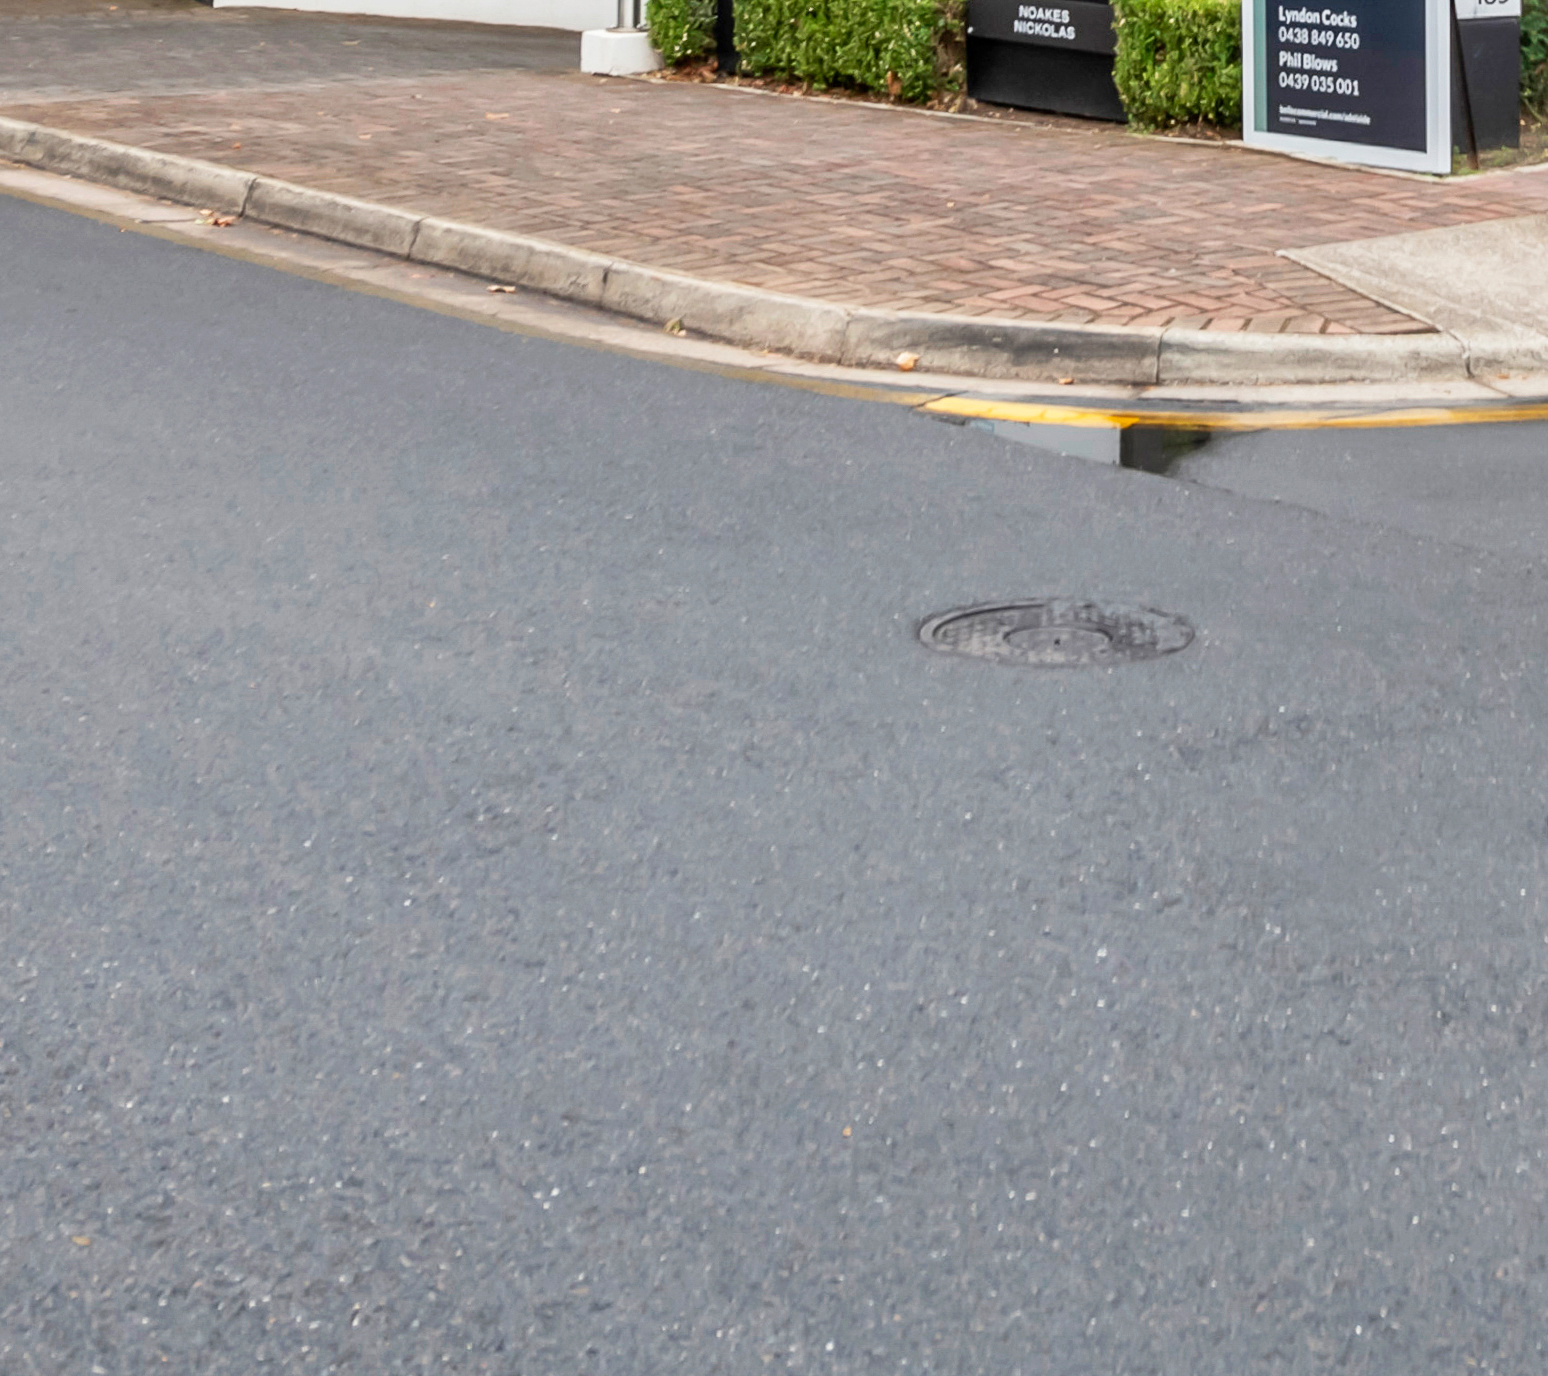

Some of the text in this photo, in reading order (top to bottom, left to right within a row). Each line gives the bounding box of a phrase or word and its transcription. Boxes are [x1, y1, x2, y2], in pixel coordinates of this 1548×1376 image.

[1018, 4, 1070, 24] NOAKES
[1278, 5, 1357, 28] Lyndon Cocks
[1013, 20, 1076, 40] NICKOLAS
[1278, 26, 1360, 50] 0438 849 650
[1278, 50, 1338, 73] Phil Blows
[1278, 71, 1360, 96] 0439 035 001
